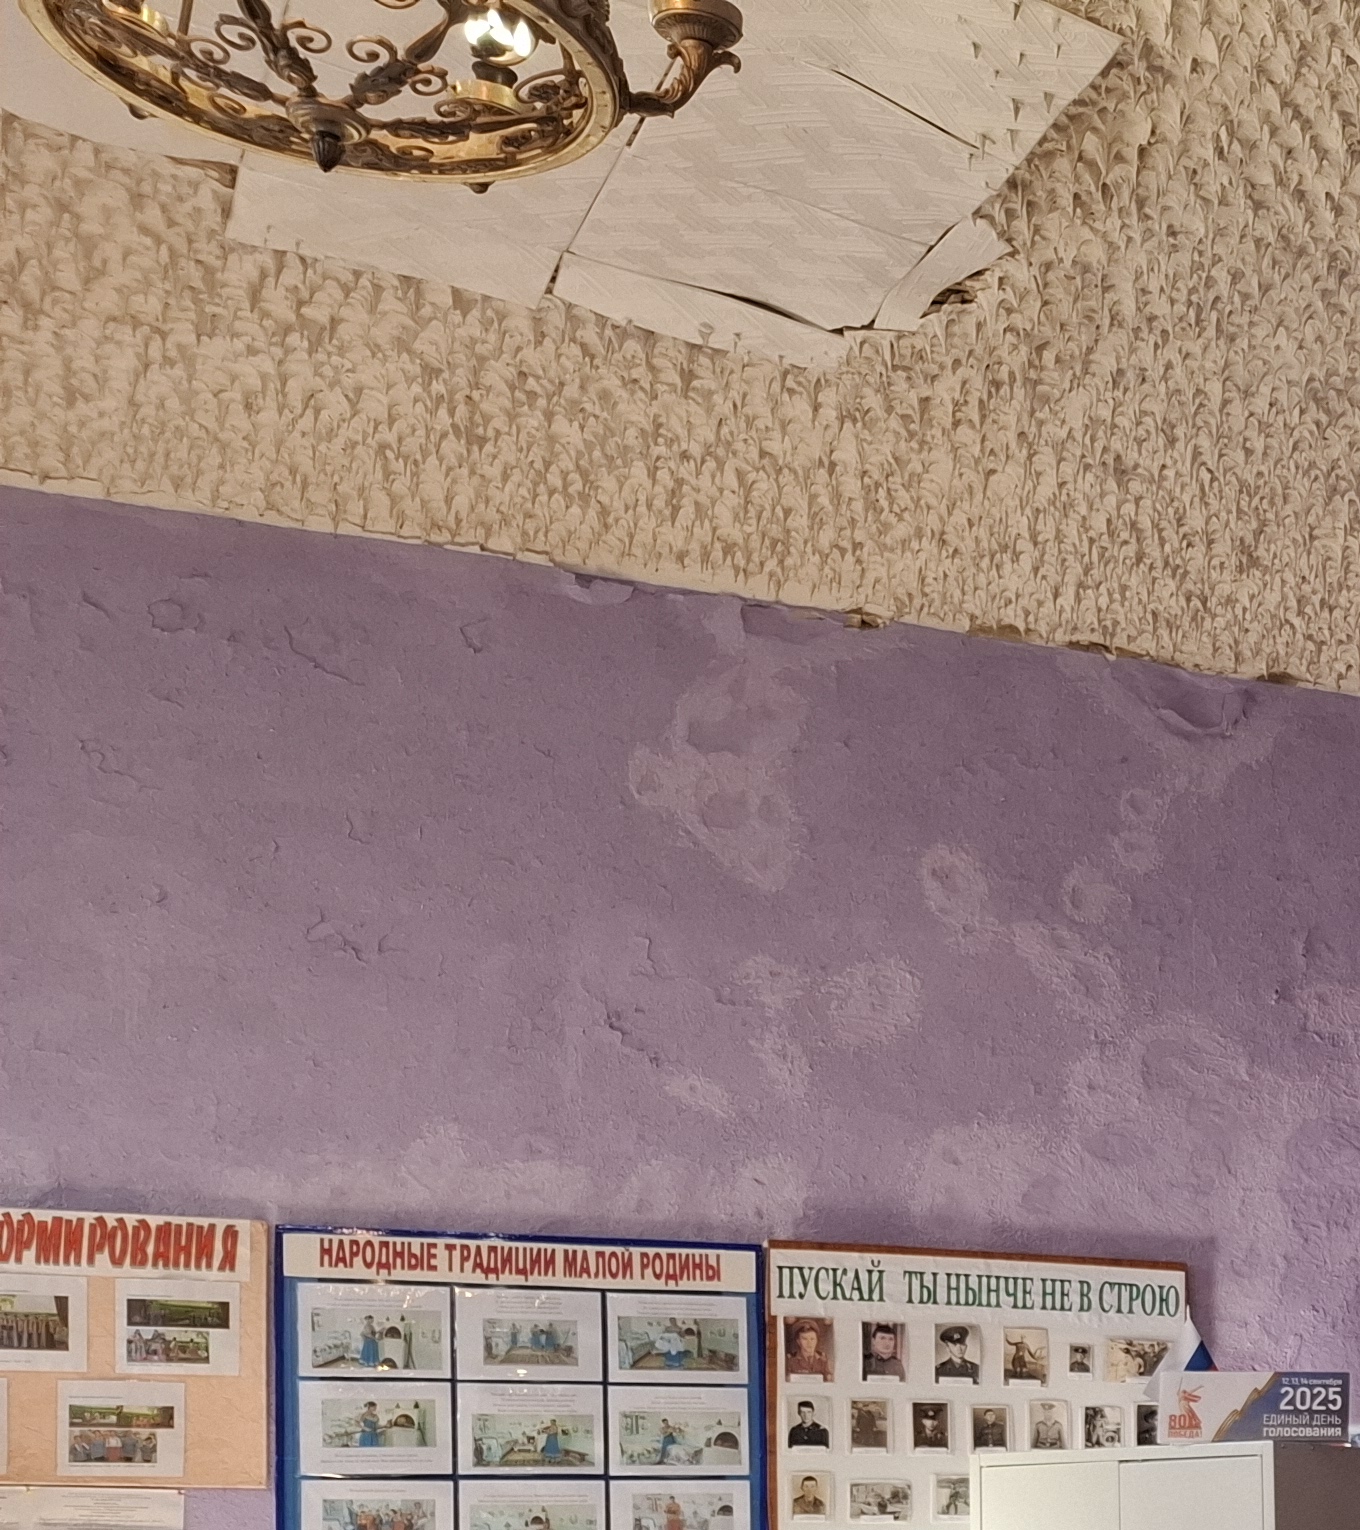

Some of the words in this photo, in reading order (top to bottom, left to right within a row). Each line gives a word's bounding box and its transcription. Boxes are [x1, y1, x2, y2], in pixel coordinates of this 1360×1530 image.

[319, 1237, 438, 1277] НАРОДНЫЕ
[444, 1243, 556, 1282] ТРАДИЦИИ
[563, 1246, 634, 1280] МАЛОЙ
[640, 1252, 721, 1287] РОДИНЫ
[776, 1260, 886, 1303] ПУСКАЙ
[903, 1270, 938, 1305] ТЫ
[944, 1272, 1035, 1310] НЫНЧЕ
[1040, 1278, 1073, 1312] НЕ
[1078, 1280, 1093, 1313] В
[1098, 1280, 1181, 1318] СТРОЮ
[1279, 1387, 1343, 1411] 2025
[1169, 1414, 1187, 1429] 80
[1263, 1412, 1310, 1426] ЕДИНЫЙ
[1312, 1414, 1342, 1426] ДЕНЬ
